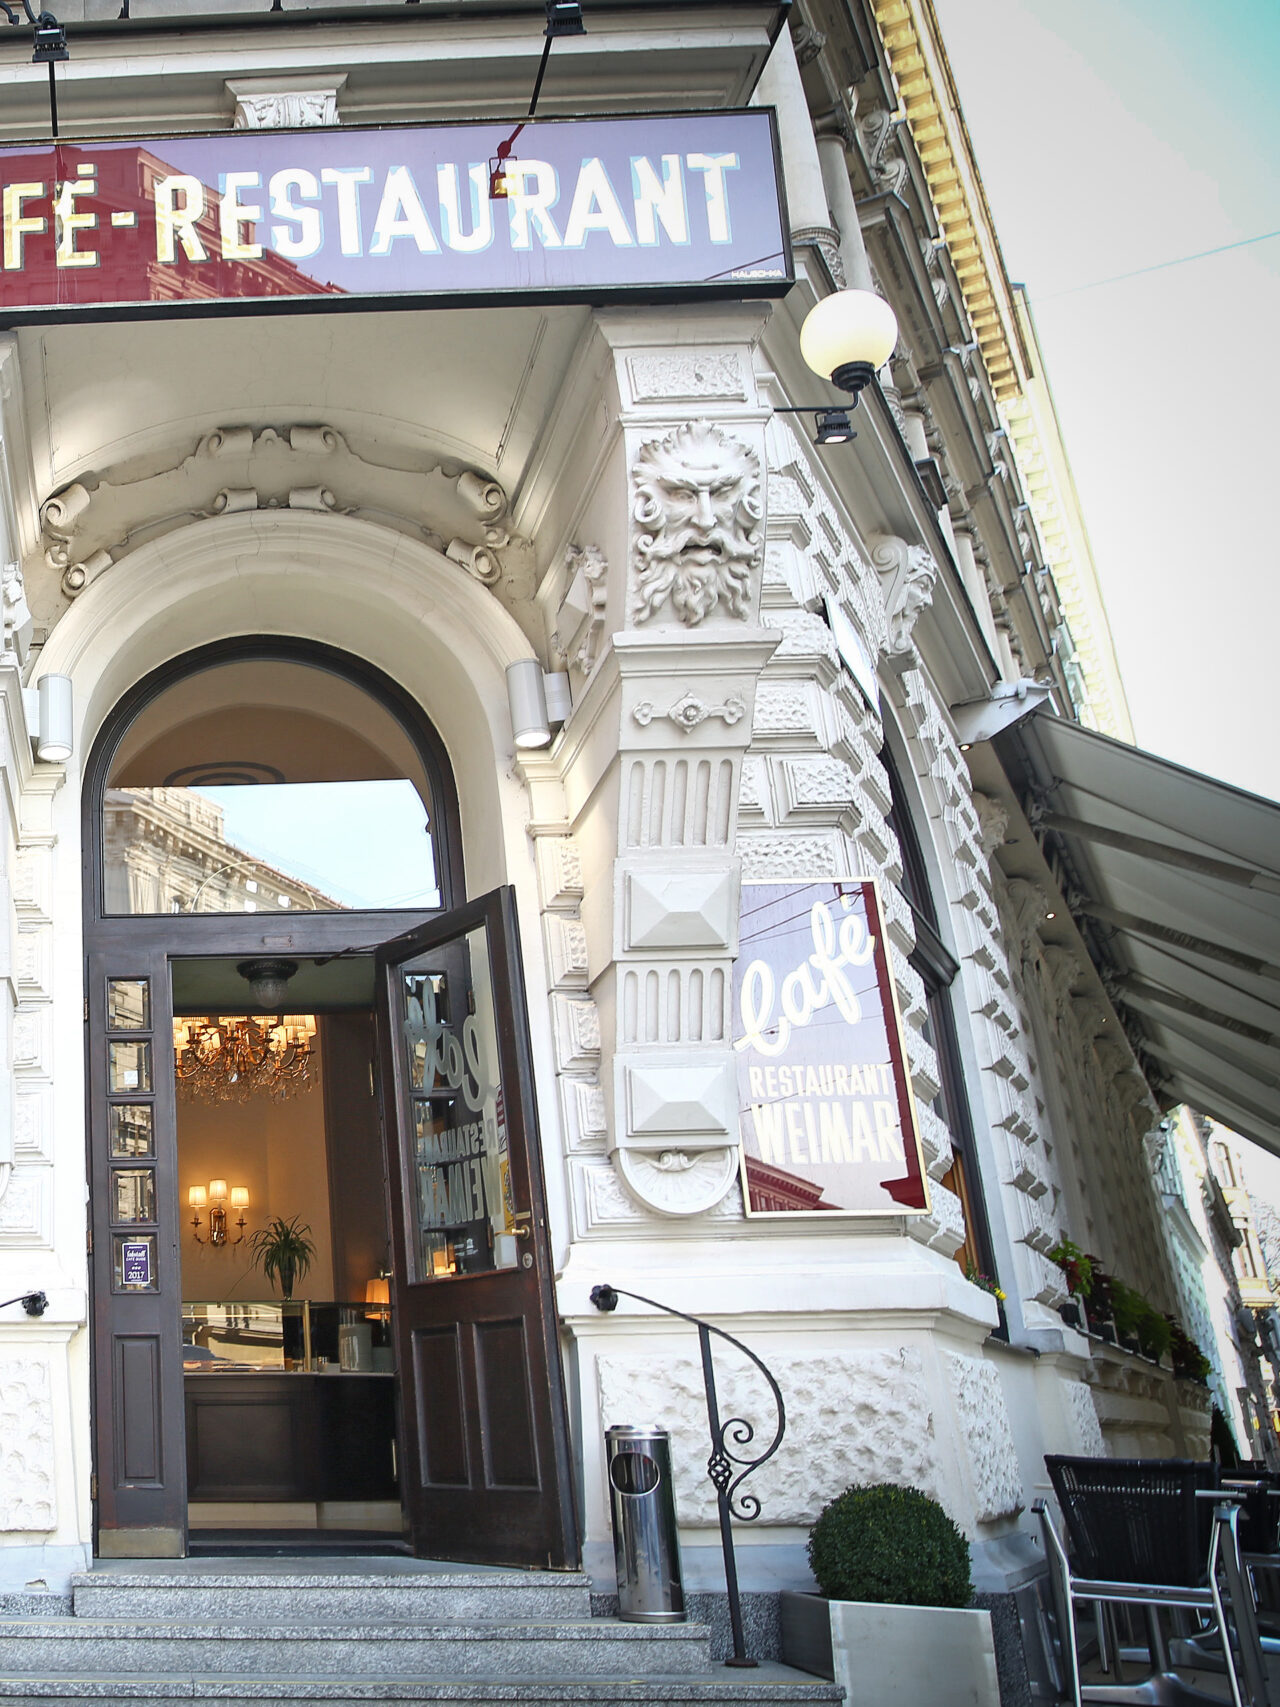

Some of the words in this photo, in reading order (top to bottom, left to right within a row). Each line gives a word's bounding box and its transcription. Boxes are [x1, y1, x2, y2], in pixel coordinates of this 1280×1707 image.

[749, 1062, 893, 1098] RESTAURANT
[750, 1100, 907, 1165] WEIMAR
[128, 1271, 145, 1279] 2017
